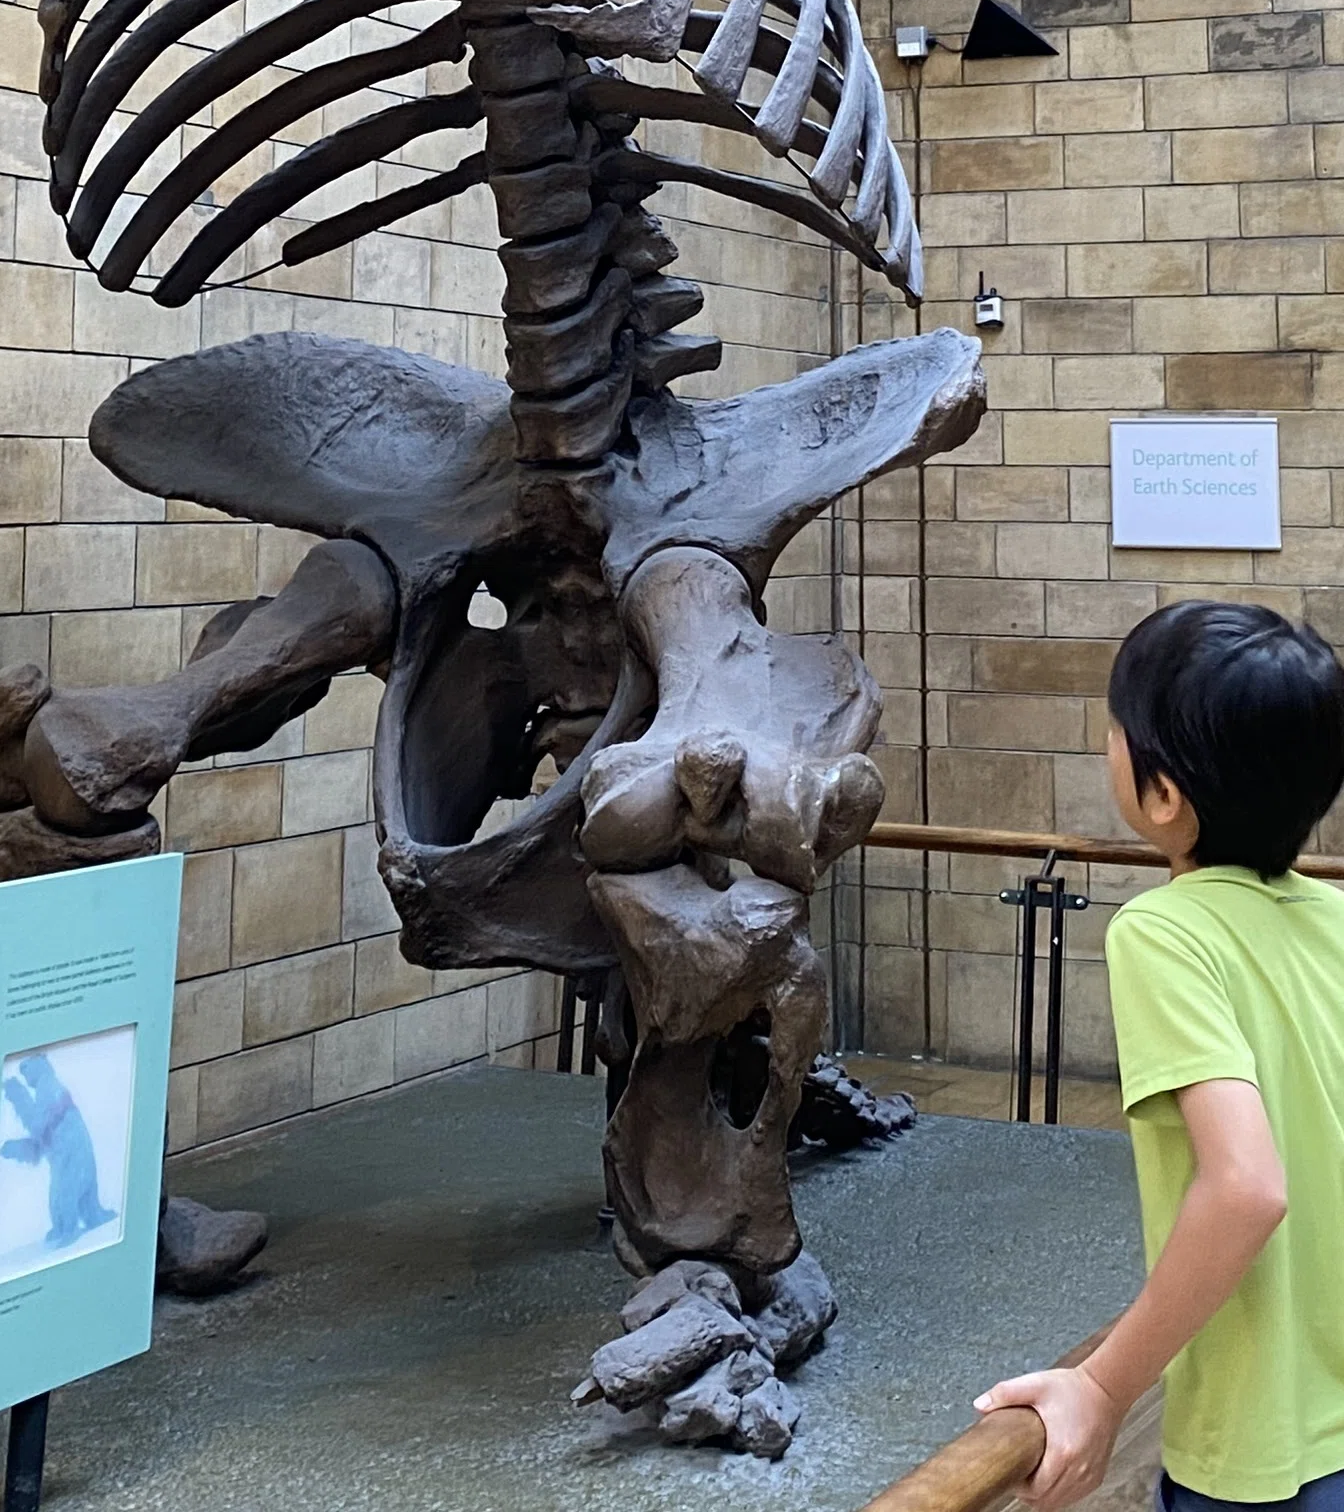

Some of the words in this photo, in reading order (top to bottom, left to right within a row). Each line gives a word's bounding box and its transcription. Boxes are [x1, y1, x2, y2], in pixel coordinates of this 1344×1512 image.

[1132, 448, 1235, 470] Department
[1240, 448, 1258, 467] of
[1133, 477, 1178, 495] Earth
[1182, 478, 1258, 496] Sciences
